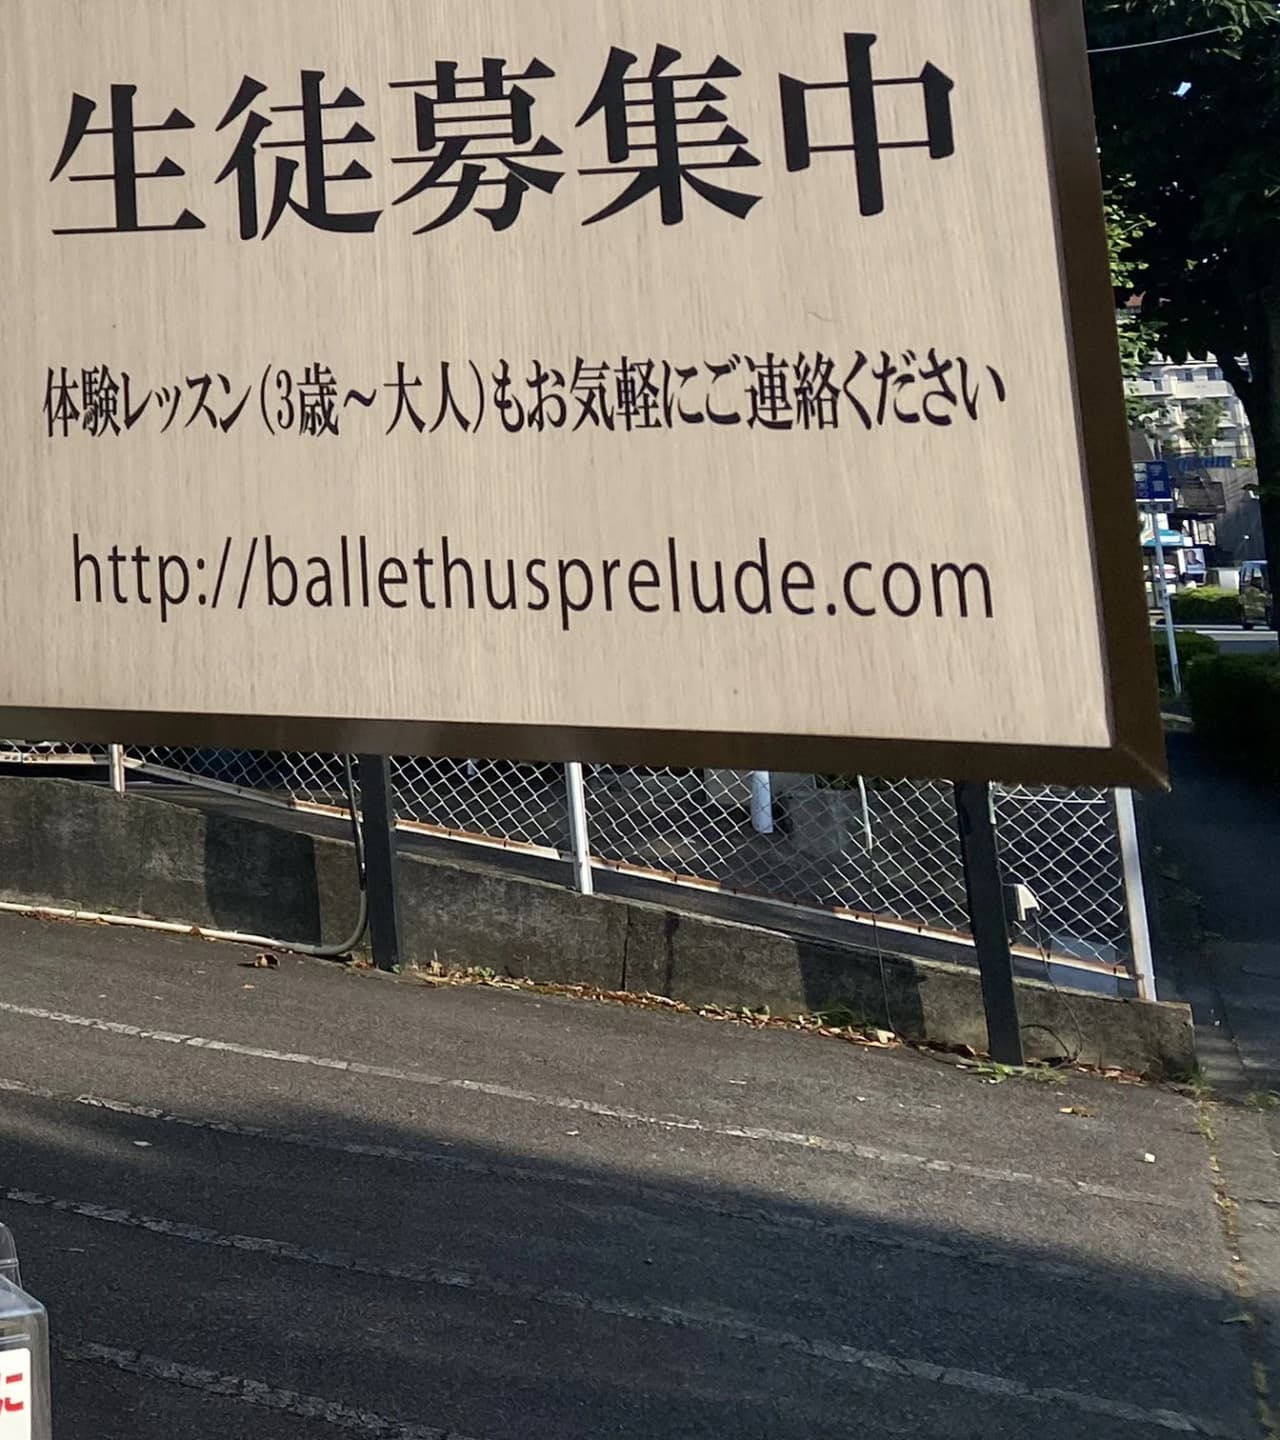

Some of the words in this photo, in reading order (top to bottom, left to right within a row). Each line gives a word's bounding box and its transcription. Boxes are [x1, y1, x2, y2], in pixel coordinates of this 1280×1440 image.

[48, 31, 956, 242] 生徒募集中
[72, 532, 995, 631] http://ballethusprelude.com
